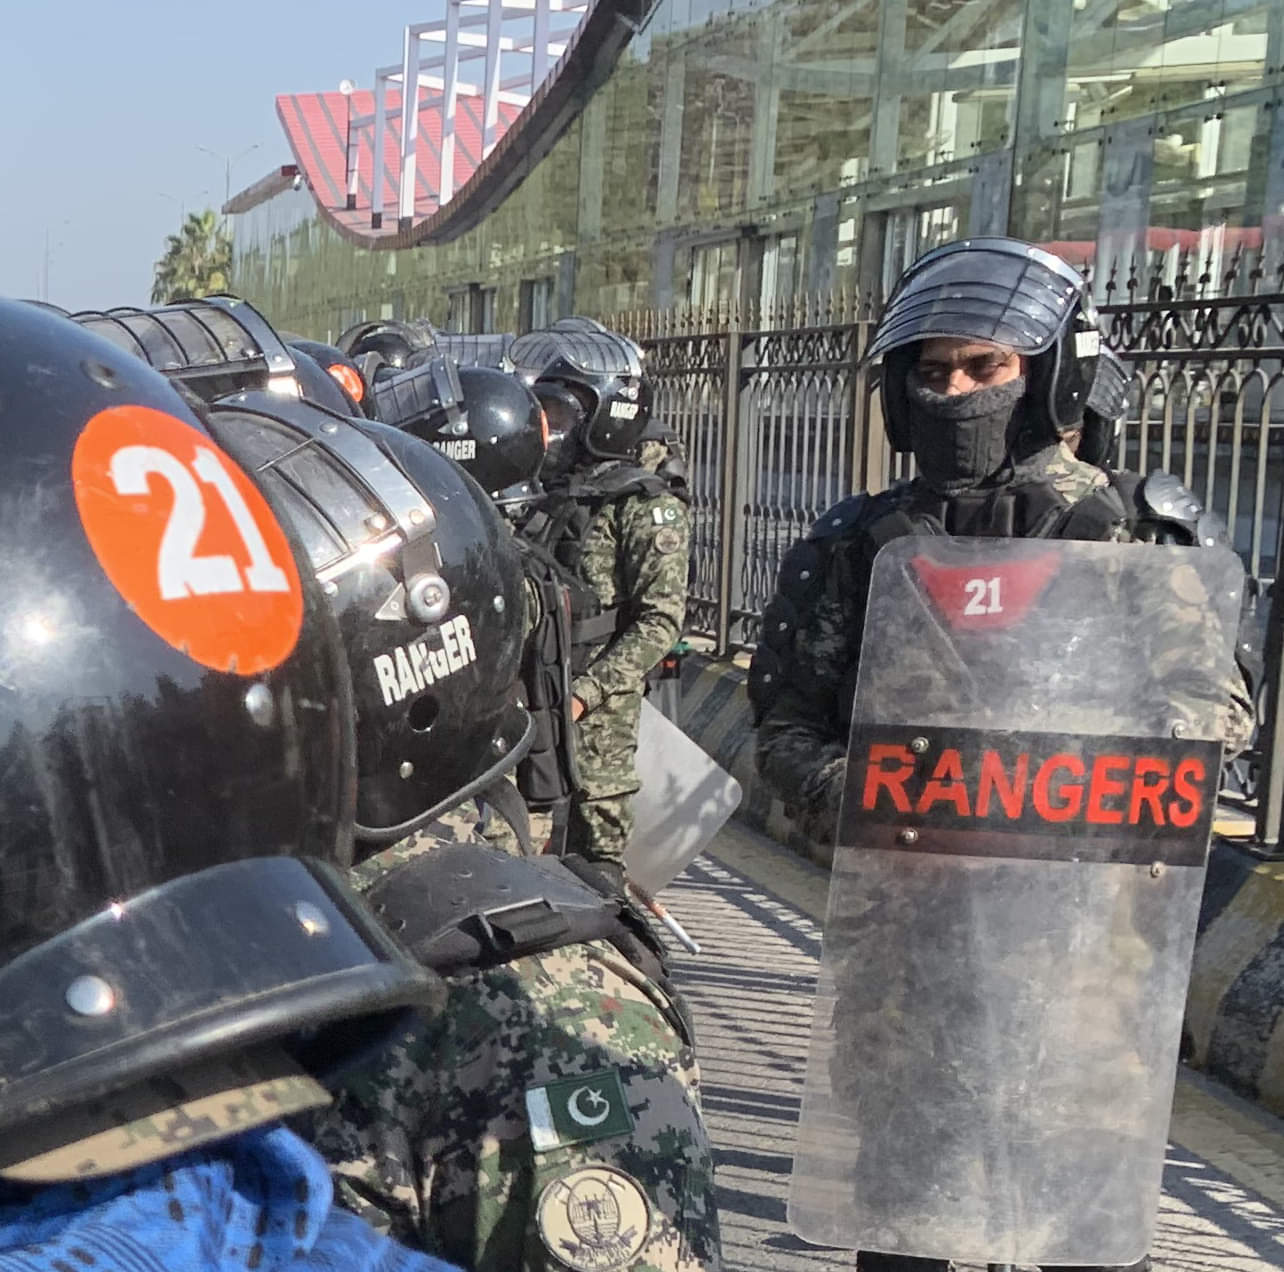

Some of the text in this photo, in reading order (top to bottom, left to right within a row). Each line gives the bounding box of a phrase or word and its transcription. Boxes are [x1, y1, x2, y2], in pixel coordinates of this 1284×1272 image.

[107, 444, 291, 601] 21
[964, 577, 1003, 616] 21
[373, 614, 477, 706] RANGER
[862, 743, 1206, 828] RANGERS
